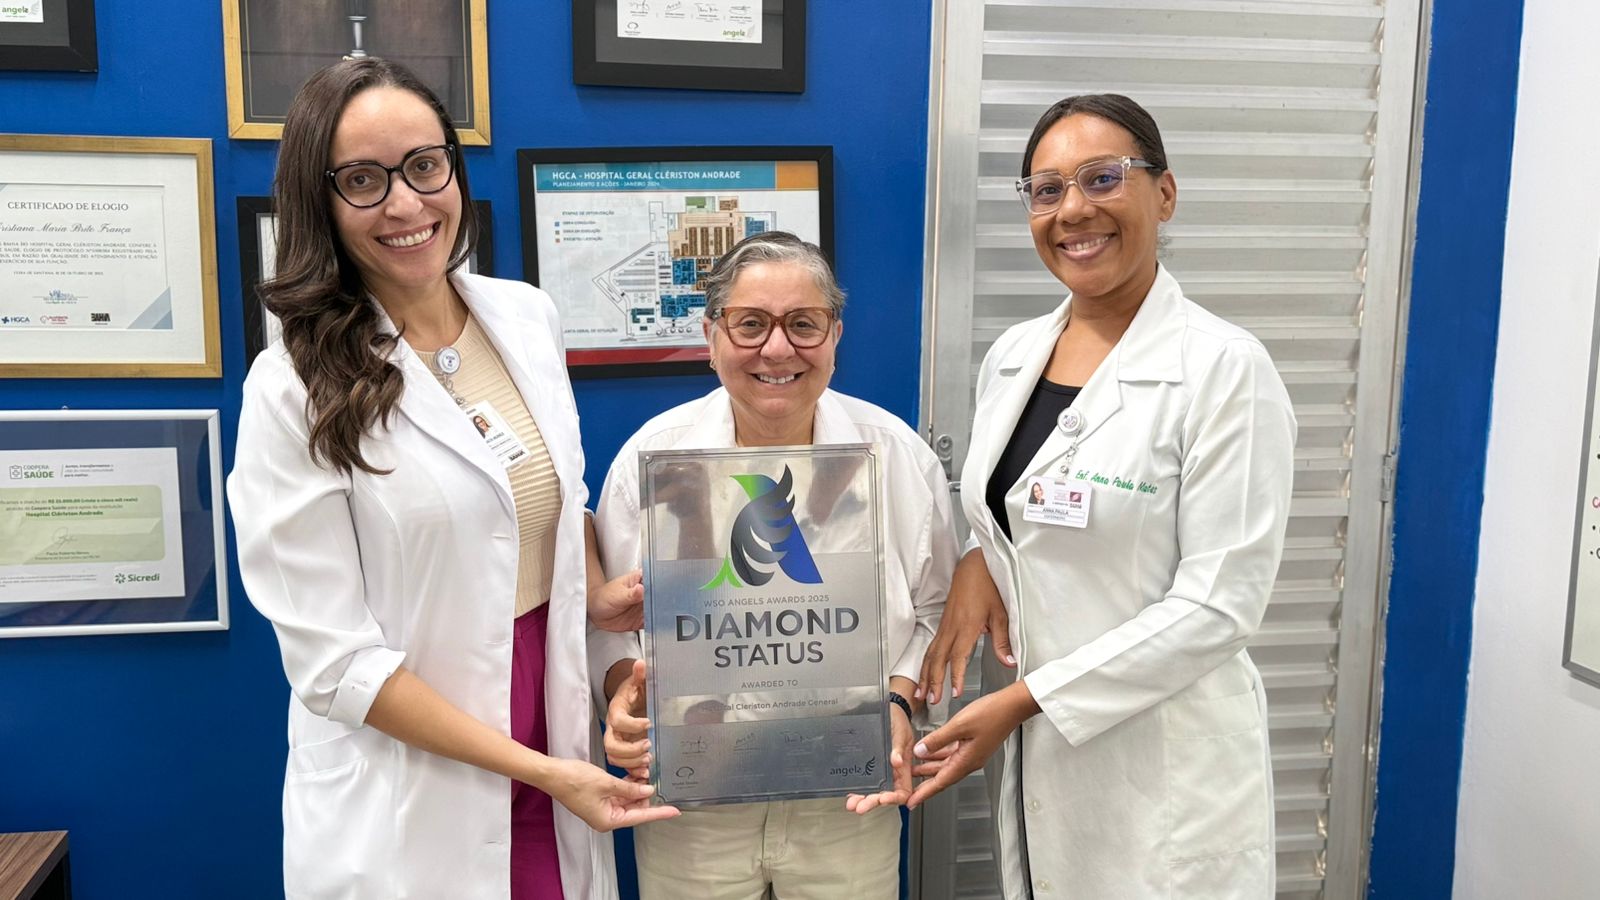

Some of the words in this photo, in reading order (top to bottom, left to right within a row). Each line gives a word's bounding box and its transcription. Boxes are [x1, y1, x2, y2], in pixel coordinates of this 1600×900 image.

[654, 170, 700, 178] CLÉRISTON
[702, 170, 741, 178] ANDRADE
[8, 202, 74, 210] CERTIFICADO
[76, 202, 89, 210] DE
[91, 202, 129, 211] ELOGIO
[37, 222, 68, 232] Maria
[24, 469, 54, 478] SAÚDE
[1090, 472, 1109, 485] Anna
[1112, 476, 1134, 490] Paula
[128, 573, 160, 582] Sicredi
[728, 598, 764, 606] ANGELS
[766, 596, 805, 604] AWARDS
[808, 594, 829, 602] 2025
[676, 608, 859, 642] DIAMOND
[714, 641, 823, 668] STATUS
[741, 680, 784, 688] AWARDED
[735, 702, 770, 710] Cleriston
[773, 700, 806, 709] Andrade
[808, 698, 838, 706] General
